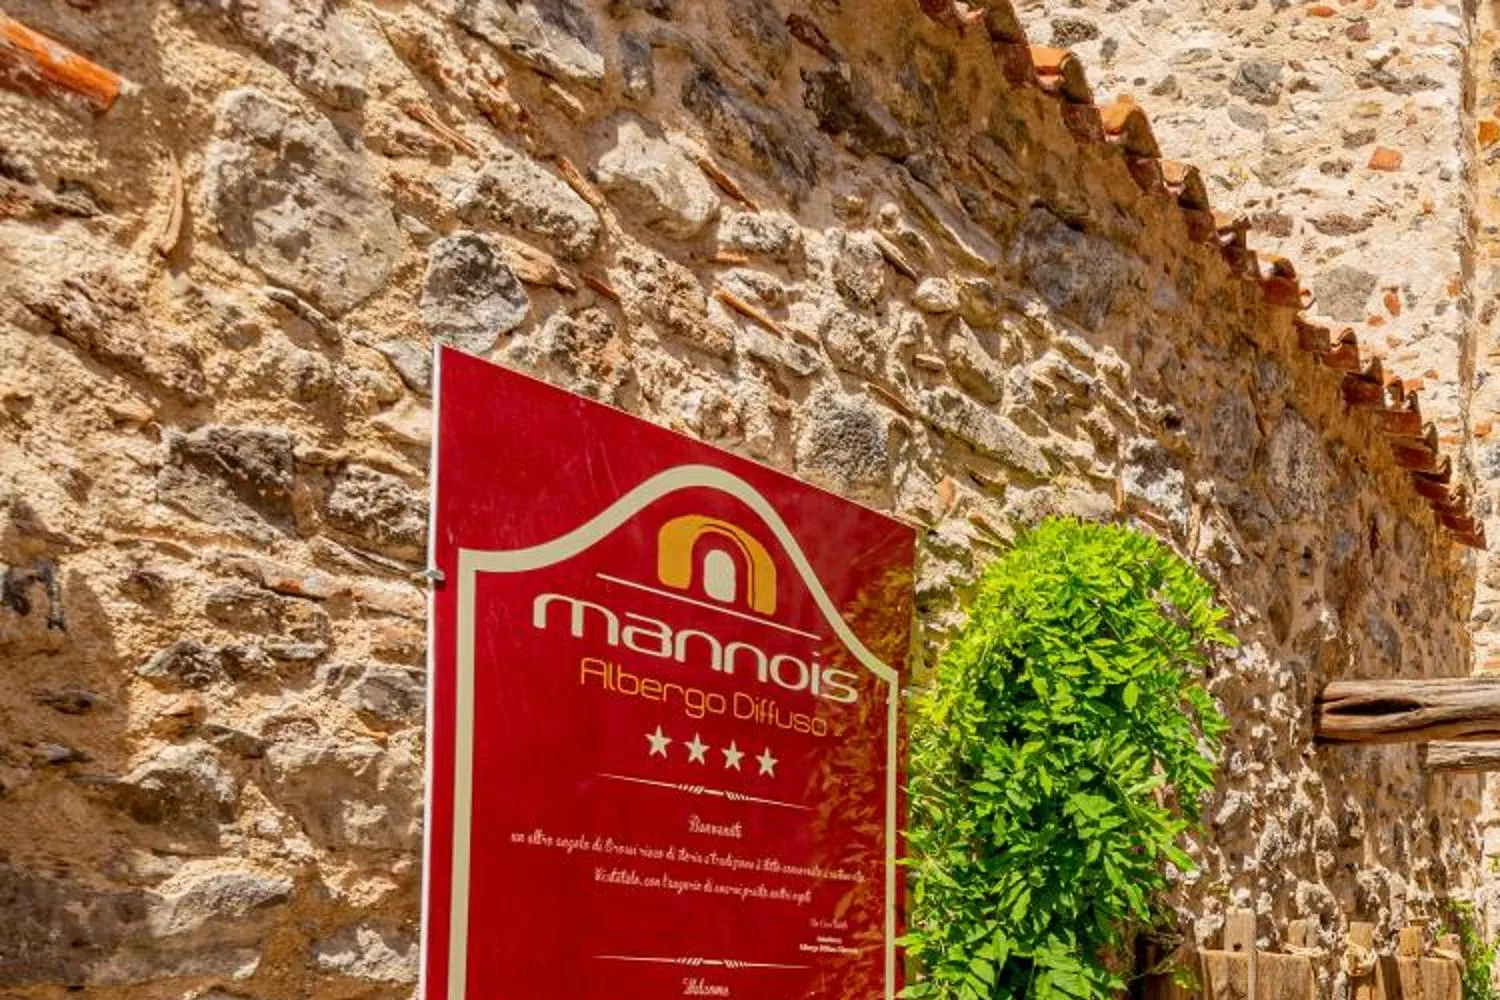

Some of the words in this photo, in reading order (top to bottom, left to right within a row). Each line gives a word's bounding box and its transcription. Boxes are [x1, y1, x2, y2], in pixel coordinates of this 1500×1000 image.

[533, 592, 860, 704] mannois
[580, 657, 726, 717] Albergo
[733, 693, 829, 737] Diffuso
